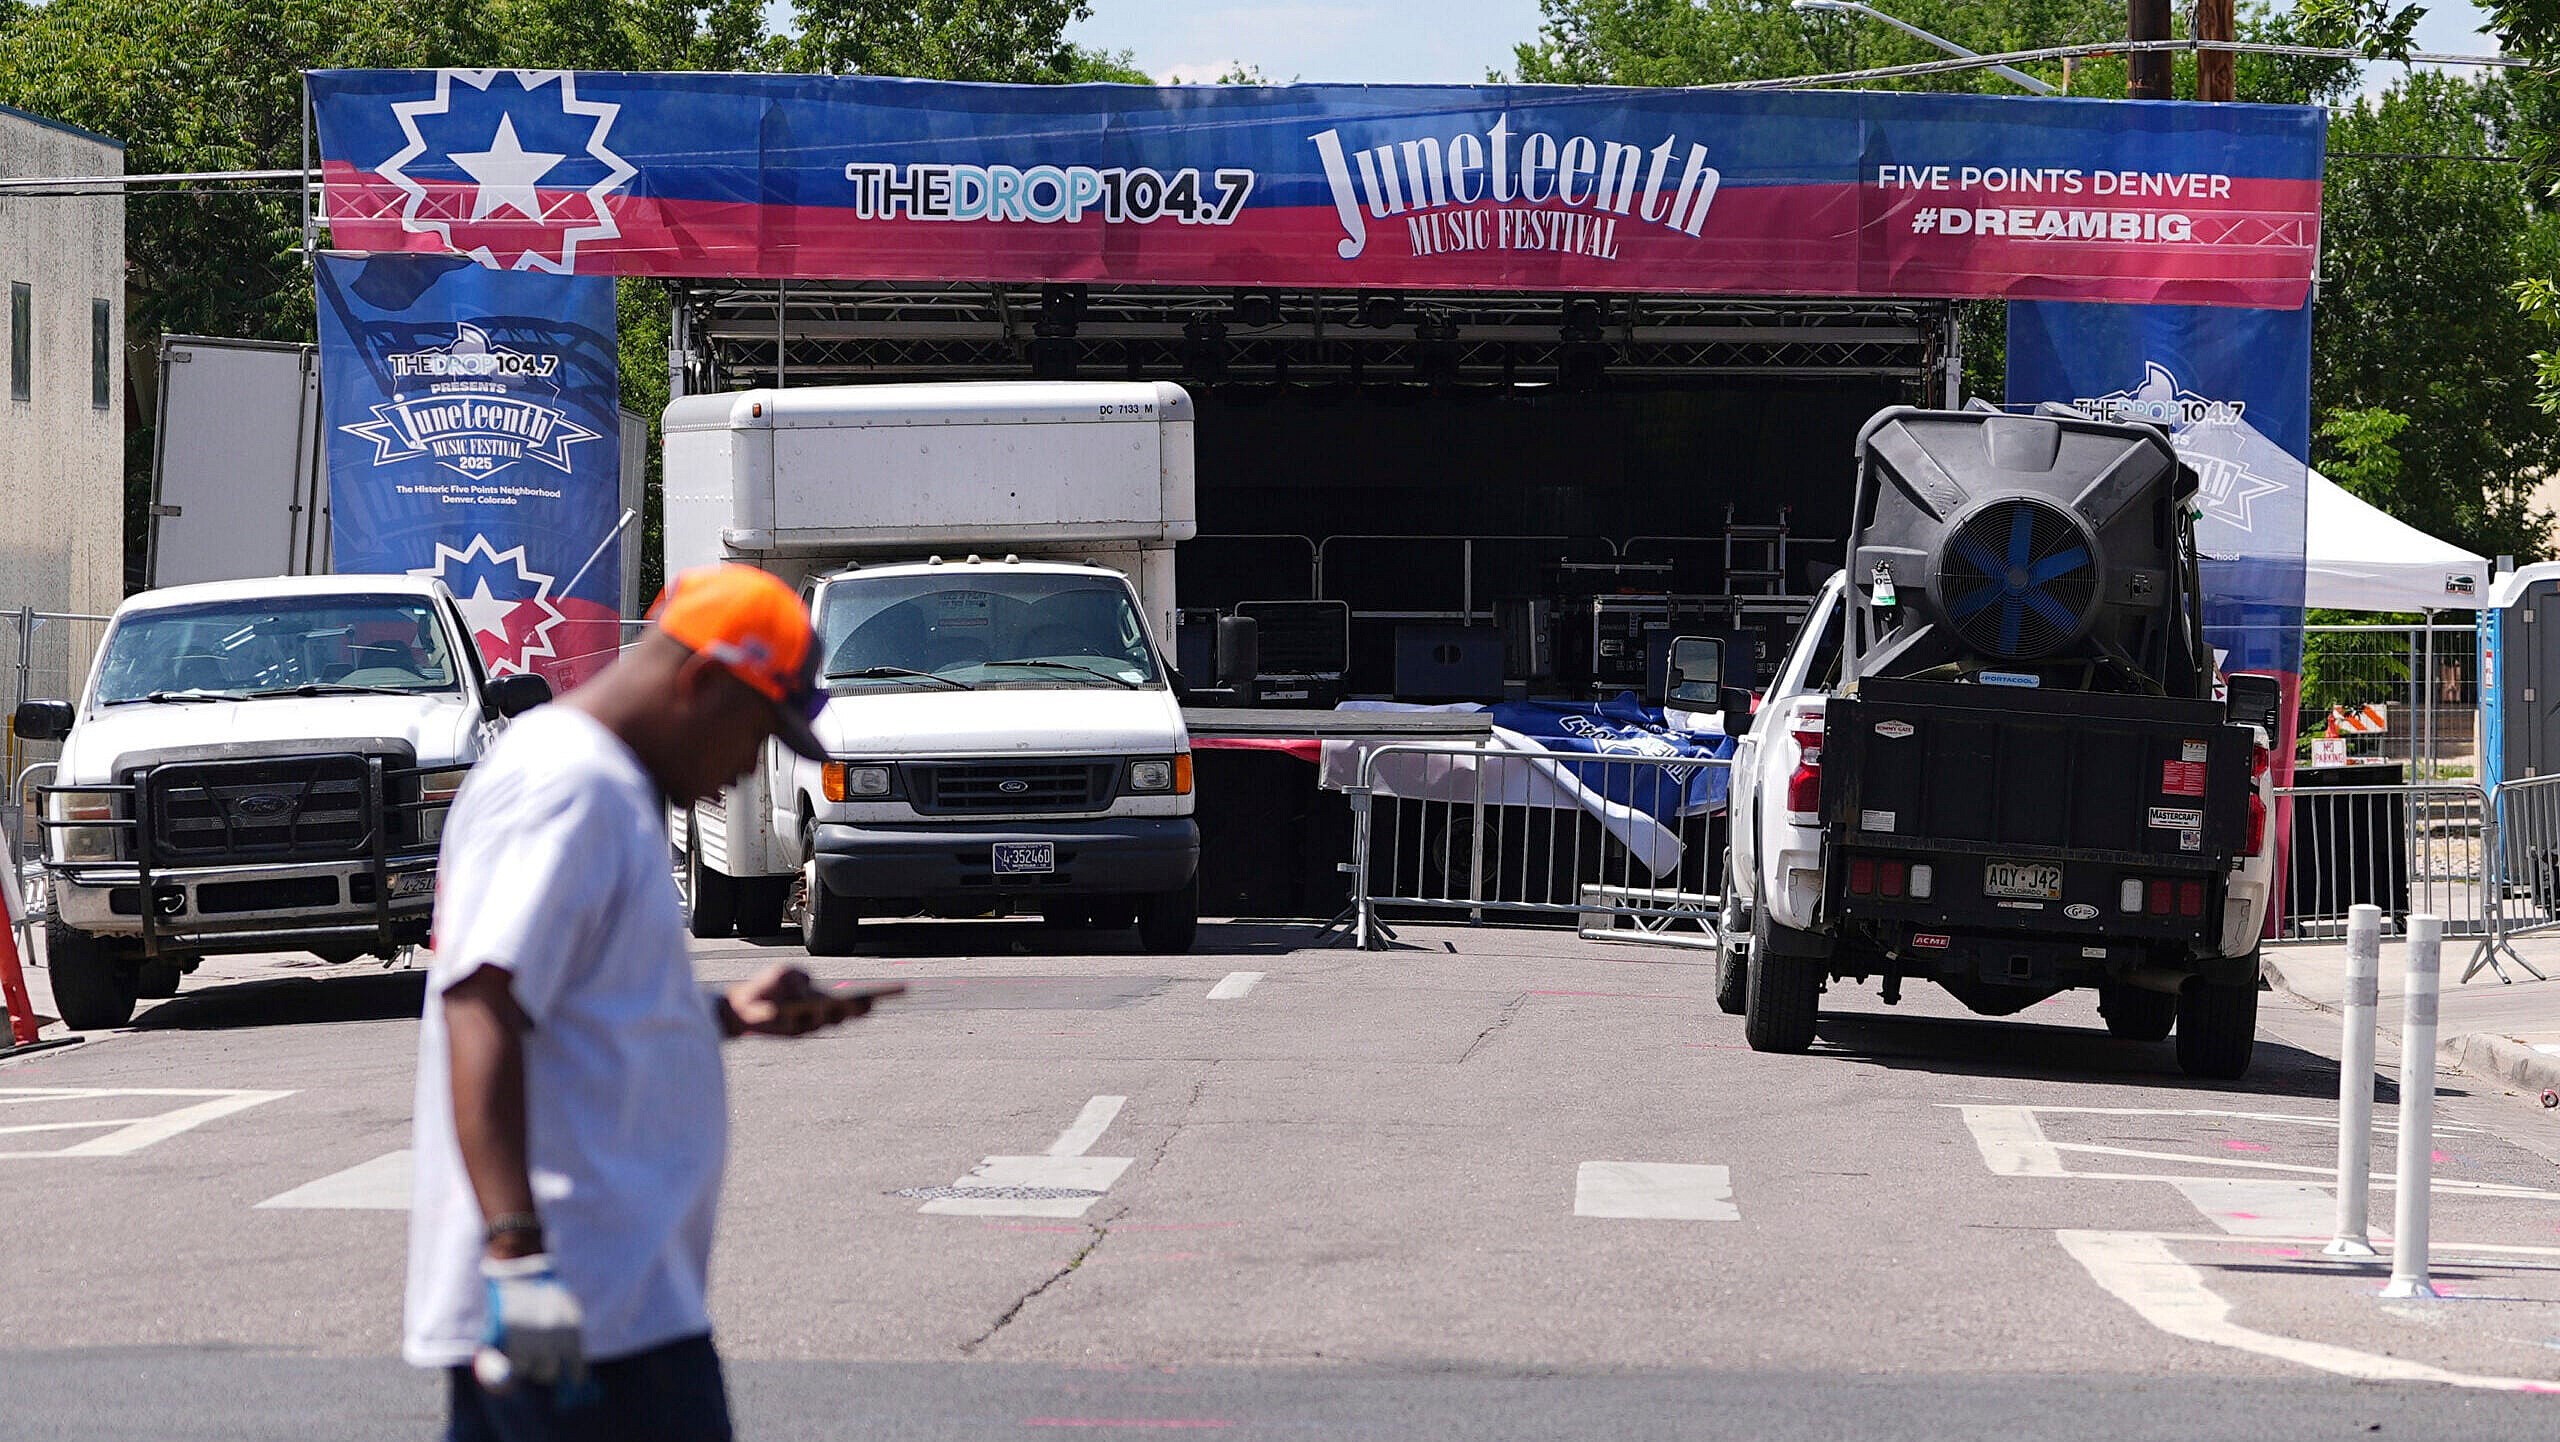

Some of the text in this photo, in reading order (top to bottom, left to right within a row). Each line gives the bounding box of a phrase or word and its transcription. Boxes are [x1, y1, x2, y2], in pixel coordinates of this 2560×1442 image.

[1307, 112, 1721, 260] Juneteenth
[1879, 165, 2232, 199] FIVE POINTS DENVER
[1911, 207, 2192, 241] #DREAMBIG
[1406, 208, 1620, 260] MUSIC FESTIVAL
[430, 381, 507, 394] PRESENTS
[1100, 404, 1153, 414] DC 7133 M
[432, 438, 523, 458] MUSIC FESTIVAL
[459, 457, 492, 469] 2025
[396, 485, 413, 493] The
[414, 485, 449, 493] Historic
[471, 485, 499, 494] Points
[500, 486, 561, 498] Neighborhood
[477, 495, 518, 505] Colorado
[2323, 742, 2335, 752] NO
[2150, 809, 2199, 821] MASTERCRAFT
